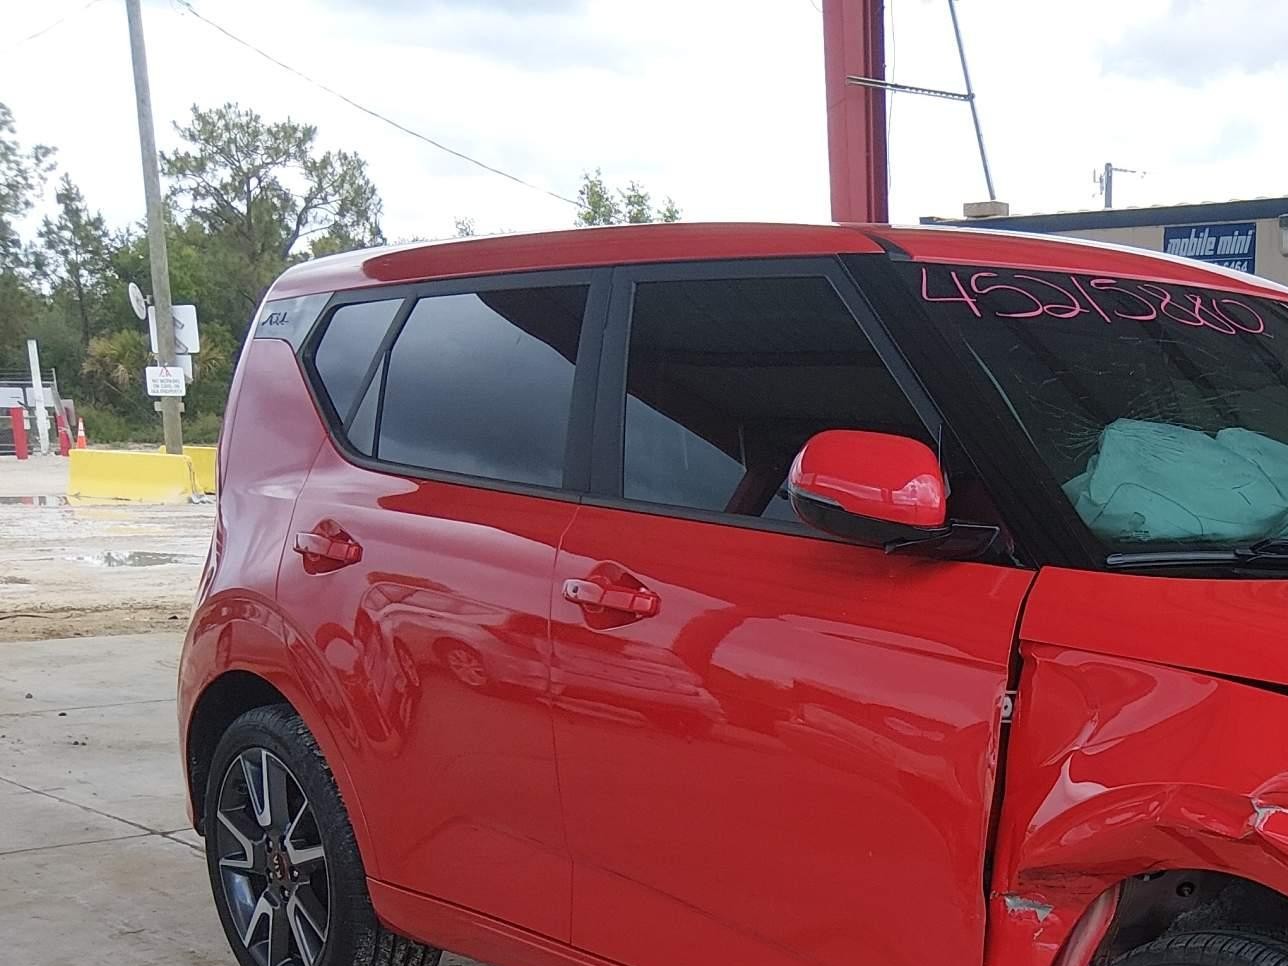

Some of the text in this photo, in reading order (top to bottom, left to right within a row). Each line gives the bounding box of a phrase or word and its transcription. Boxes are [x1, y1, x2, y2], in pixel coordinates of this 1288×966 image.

[1167, 228, 1252, 256] mobile mini
[921, 267, 1268, 334] 45215880
